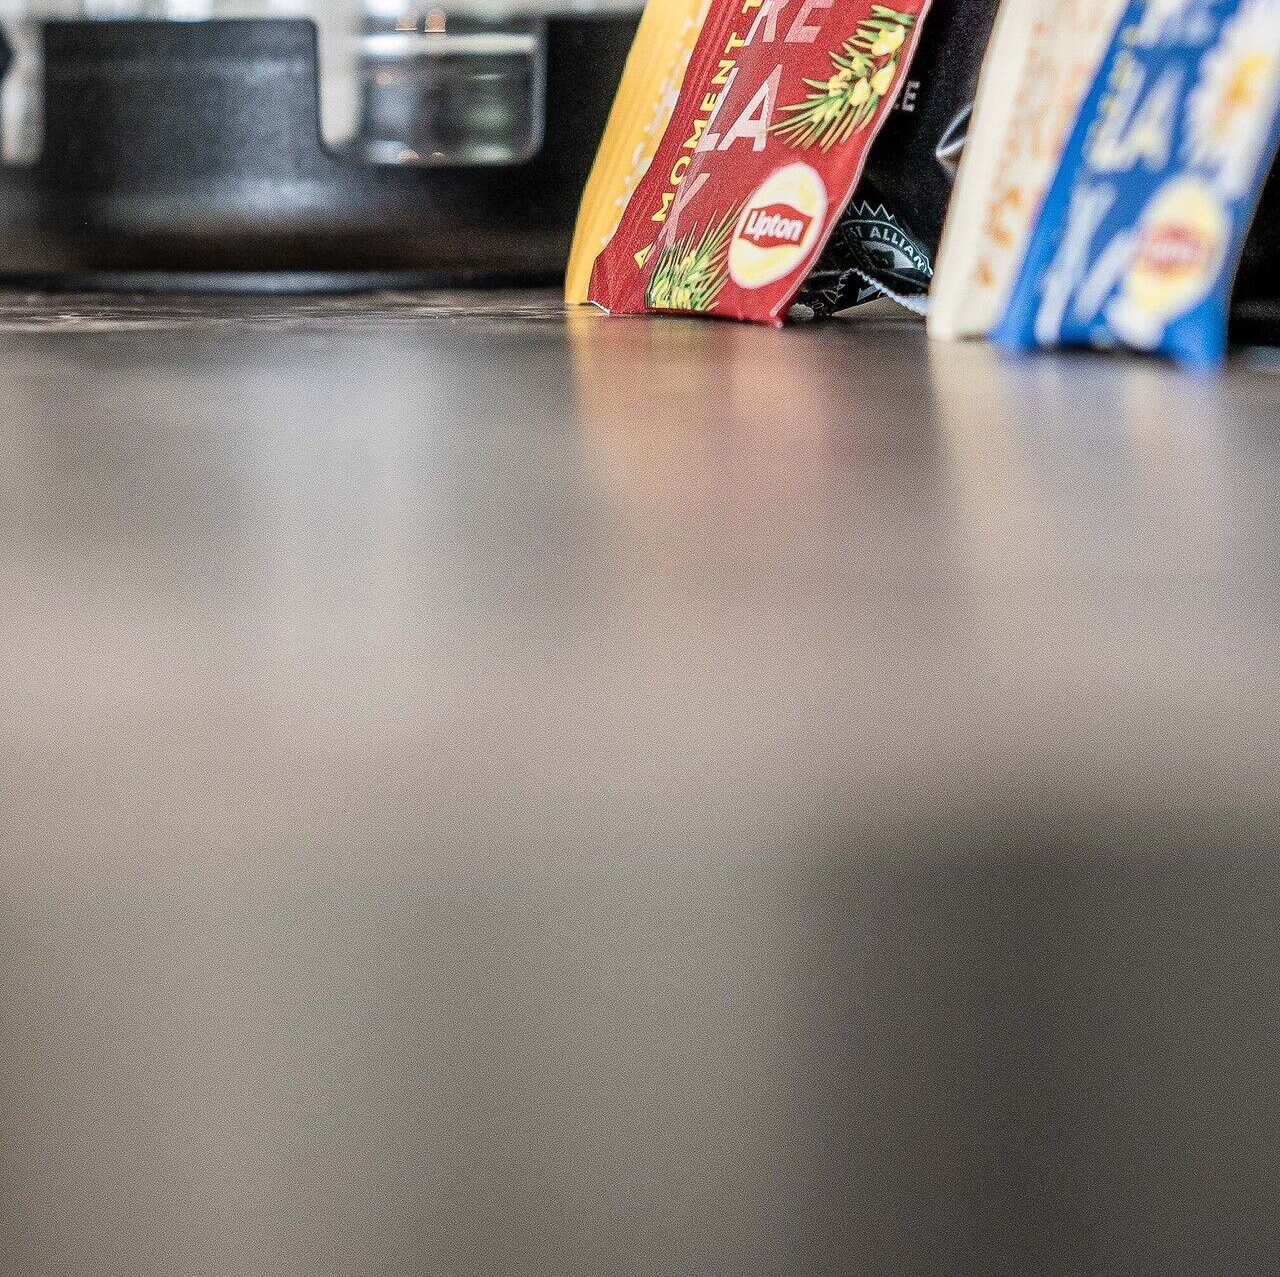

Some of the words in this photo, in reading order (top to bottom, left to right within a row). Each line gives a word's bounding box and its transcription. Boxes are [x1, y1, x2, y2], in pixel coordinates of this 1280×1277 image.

[651, 31, 745, 222] MOMENT
[693, 63, 783, 154] LA
[744, 207, 804, 243] Lipton
[869, 224, 928, 273] ALLIAN
